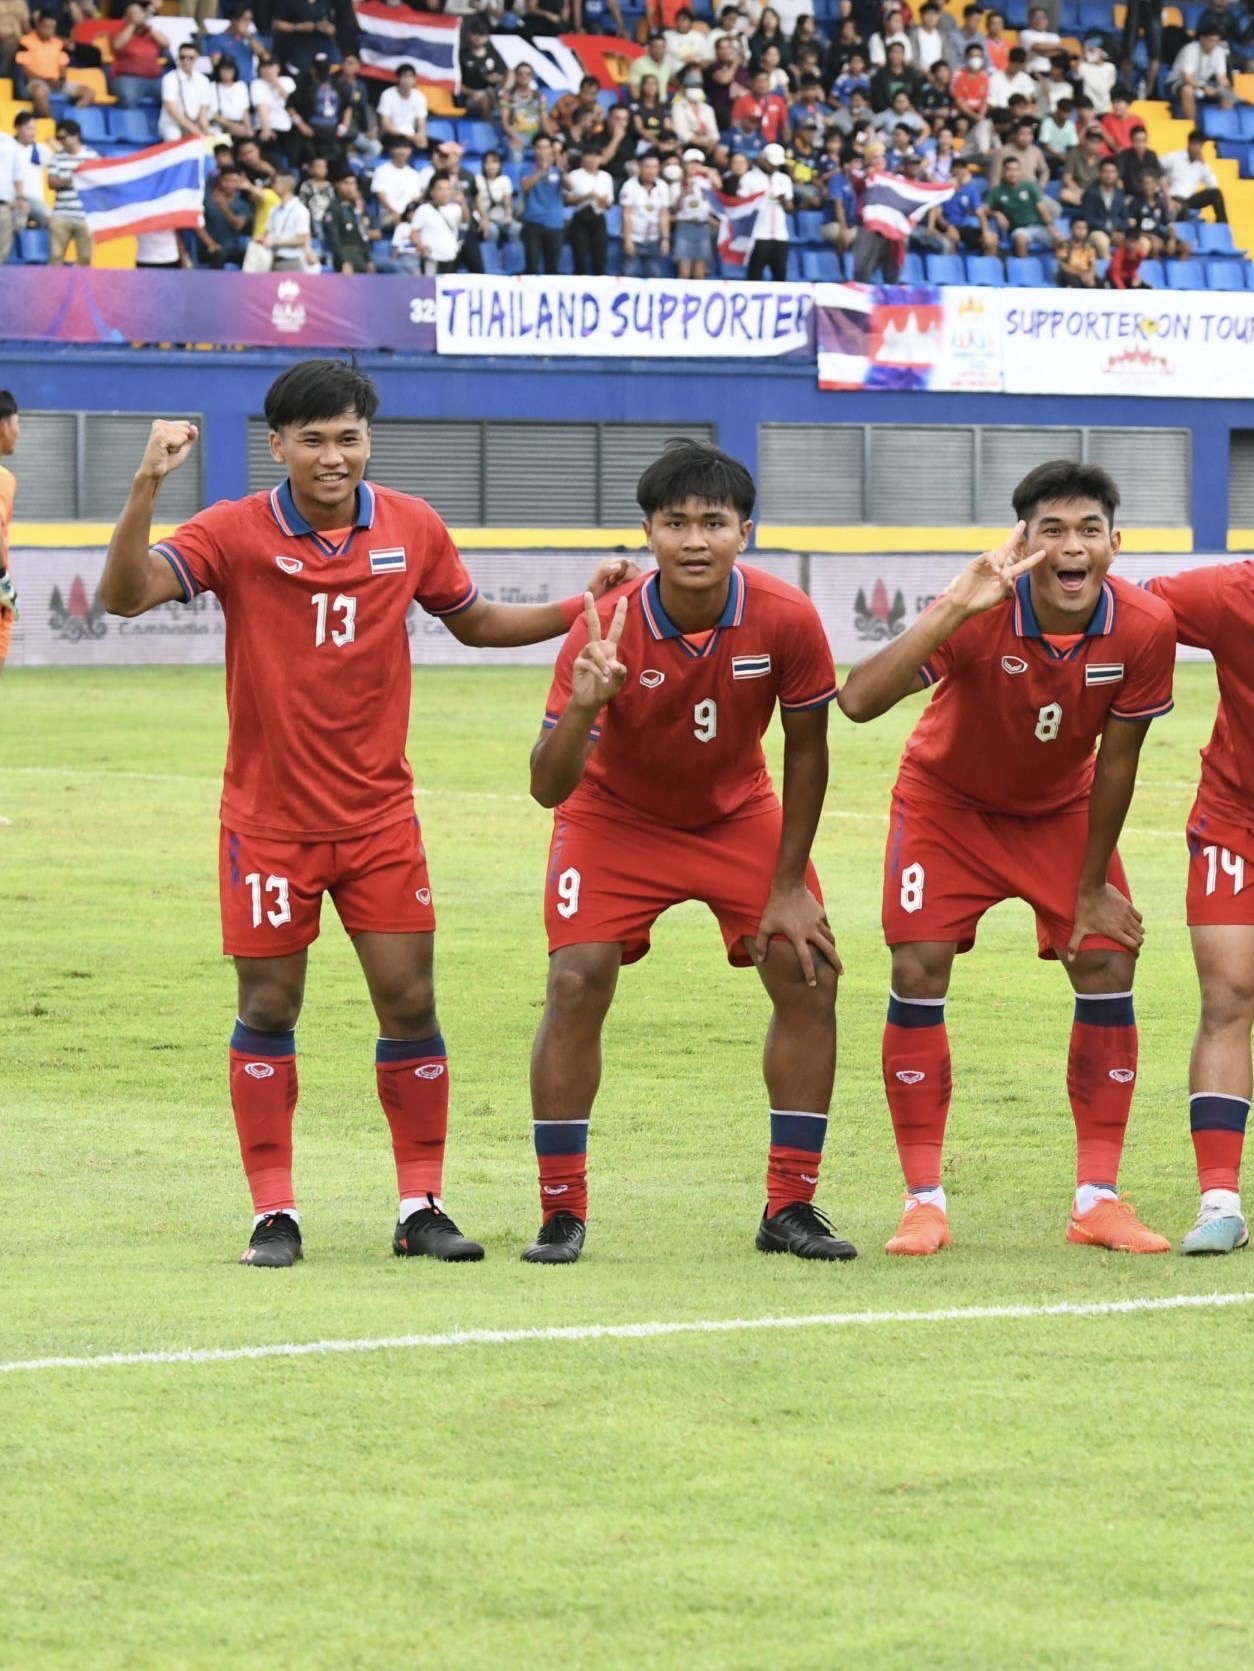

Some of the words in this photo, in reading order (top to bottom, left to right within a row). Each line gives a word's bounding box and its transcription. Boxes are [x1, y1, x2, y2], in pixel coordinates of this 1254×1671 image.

[409, 298, 436, 323] 32
[443, 288, 600, 338] THAILAND
[1006, 309, 1149, 340] SUPPORTER
[311, 592, 357, 648] 13
[694, 698, 717, 742] 9
[1034, 702, 1063, 742] 8
[557, 867, 581, 919] 9
[900, 862, 925, 913] 8
[1203, 845, 1245, 896] 14
[245, 872, 292, 929] 13
